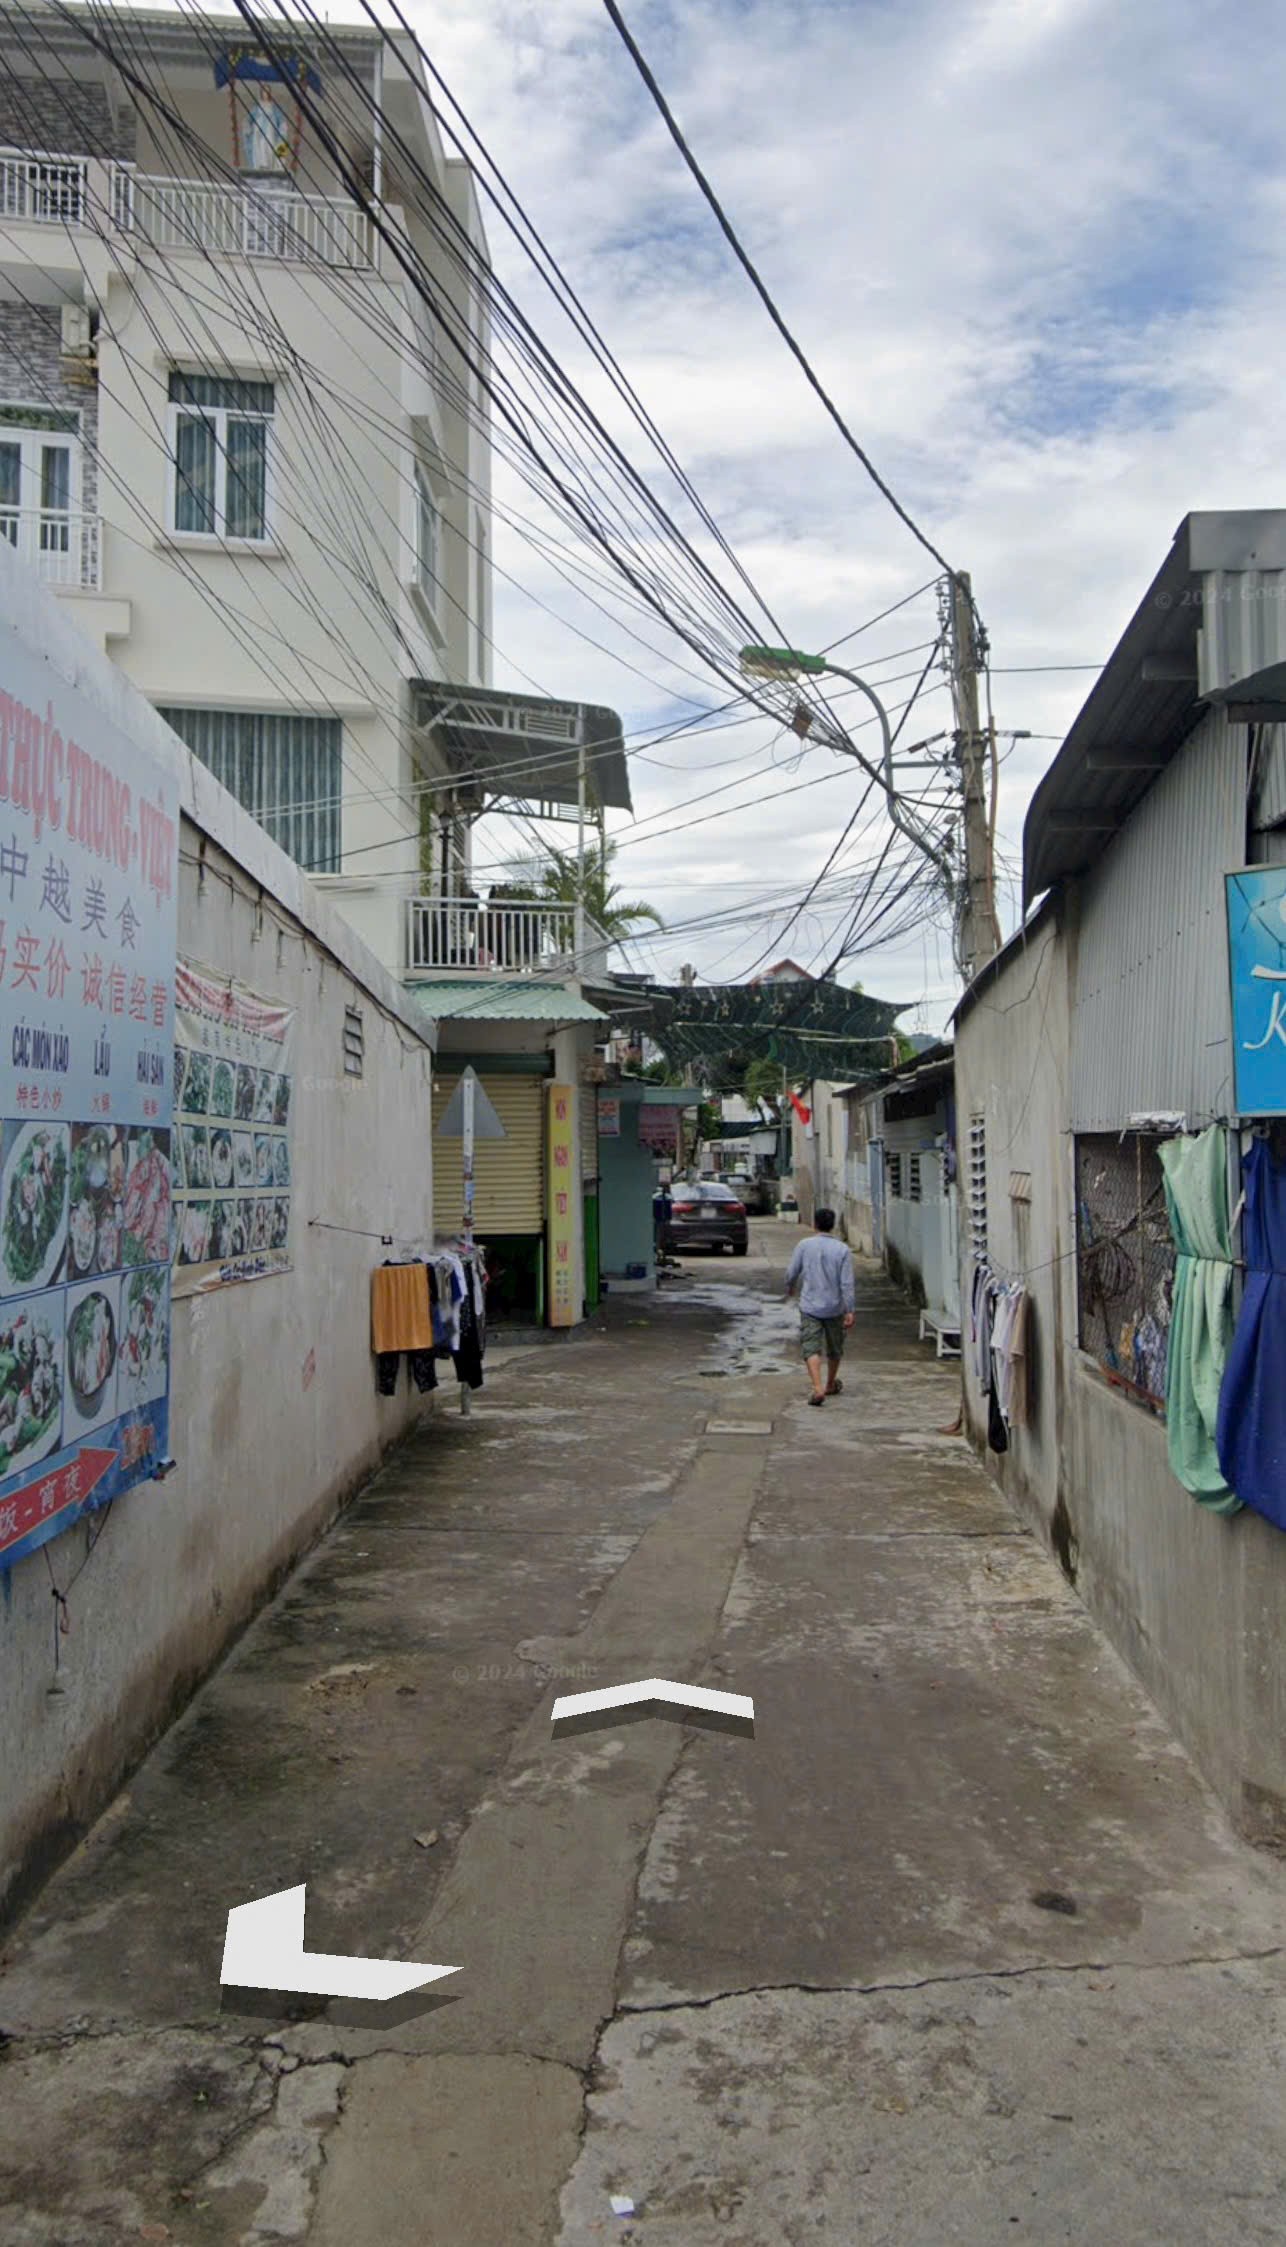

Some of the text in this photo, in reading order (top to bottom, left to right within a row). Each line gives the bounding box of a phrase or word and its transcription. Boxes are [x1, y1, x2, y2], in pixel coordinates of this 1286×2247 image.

[0, 834, 140, 951] 中越美食
[12, 1015, 31, 1068] CÁC
